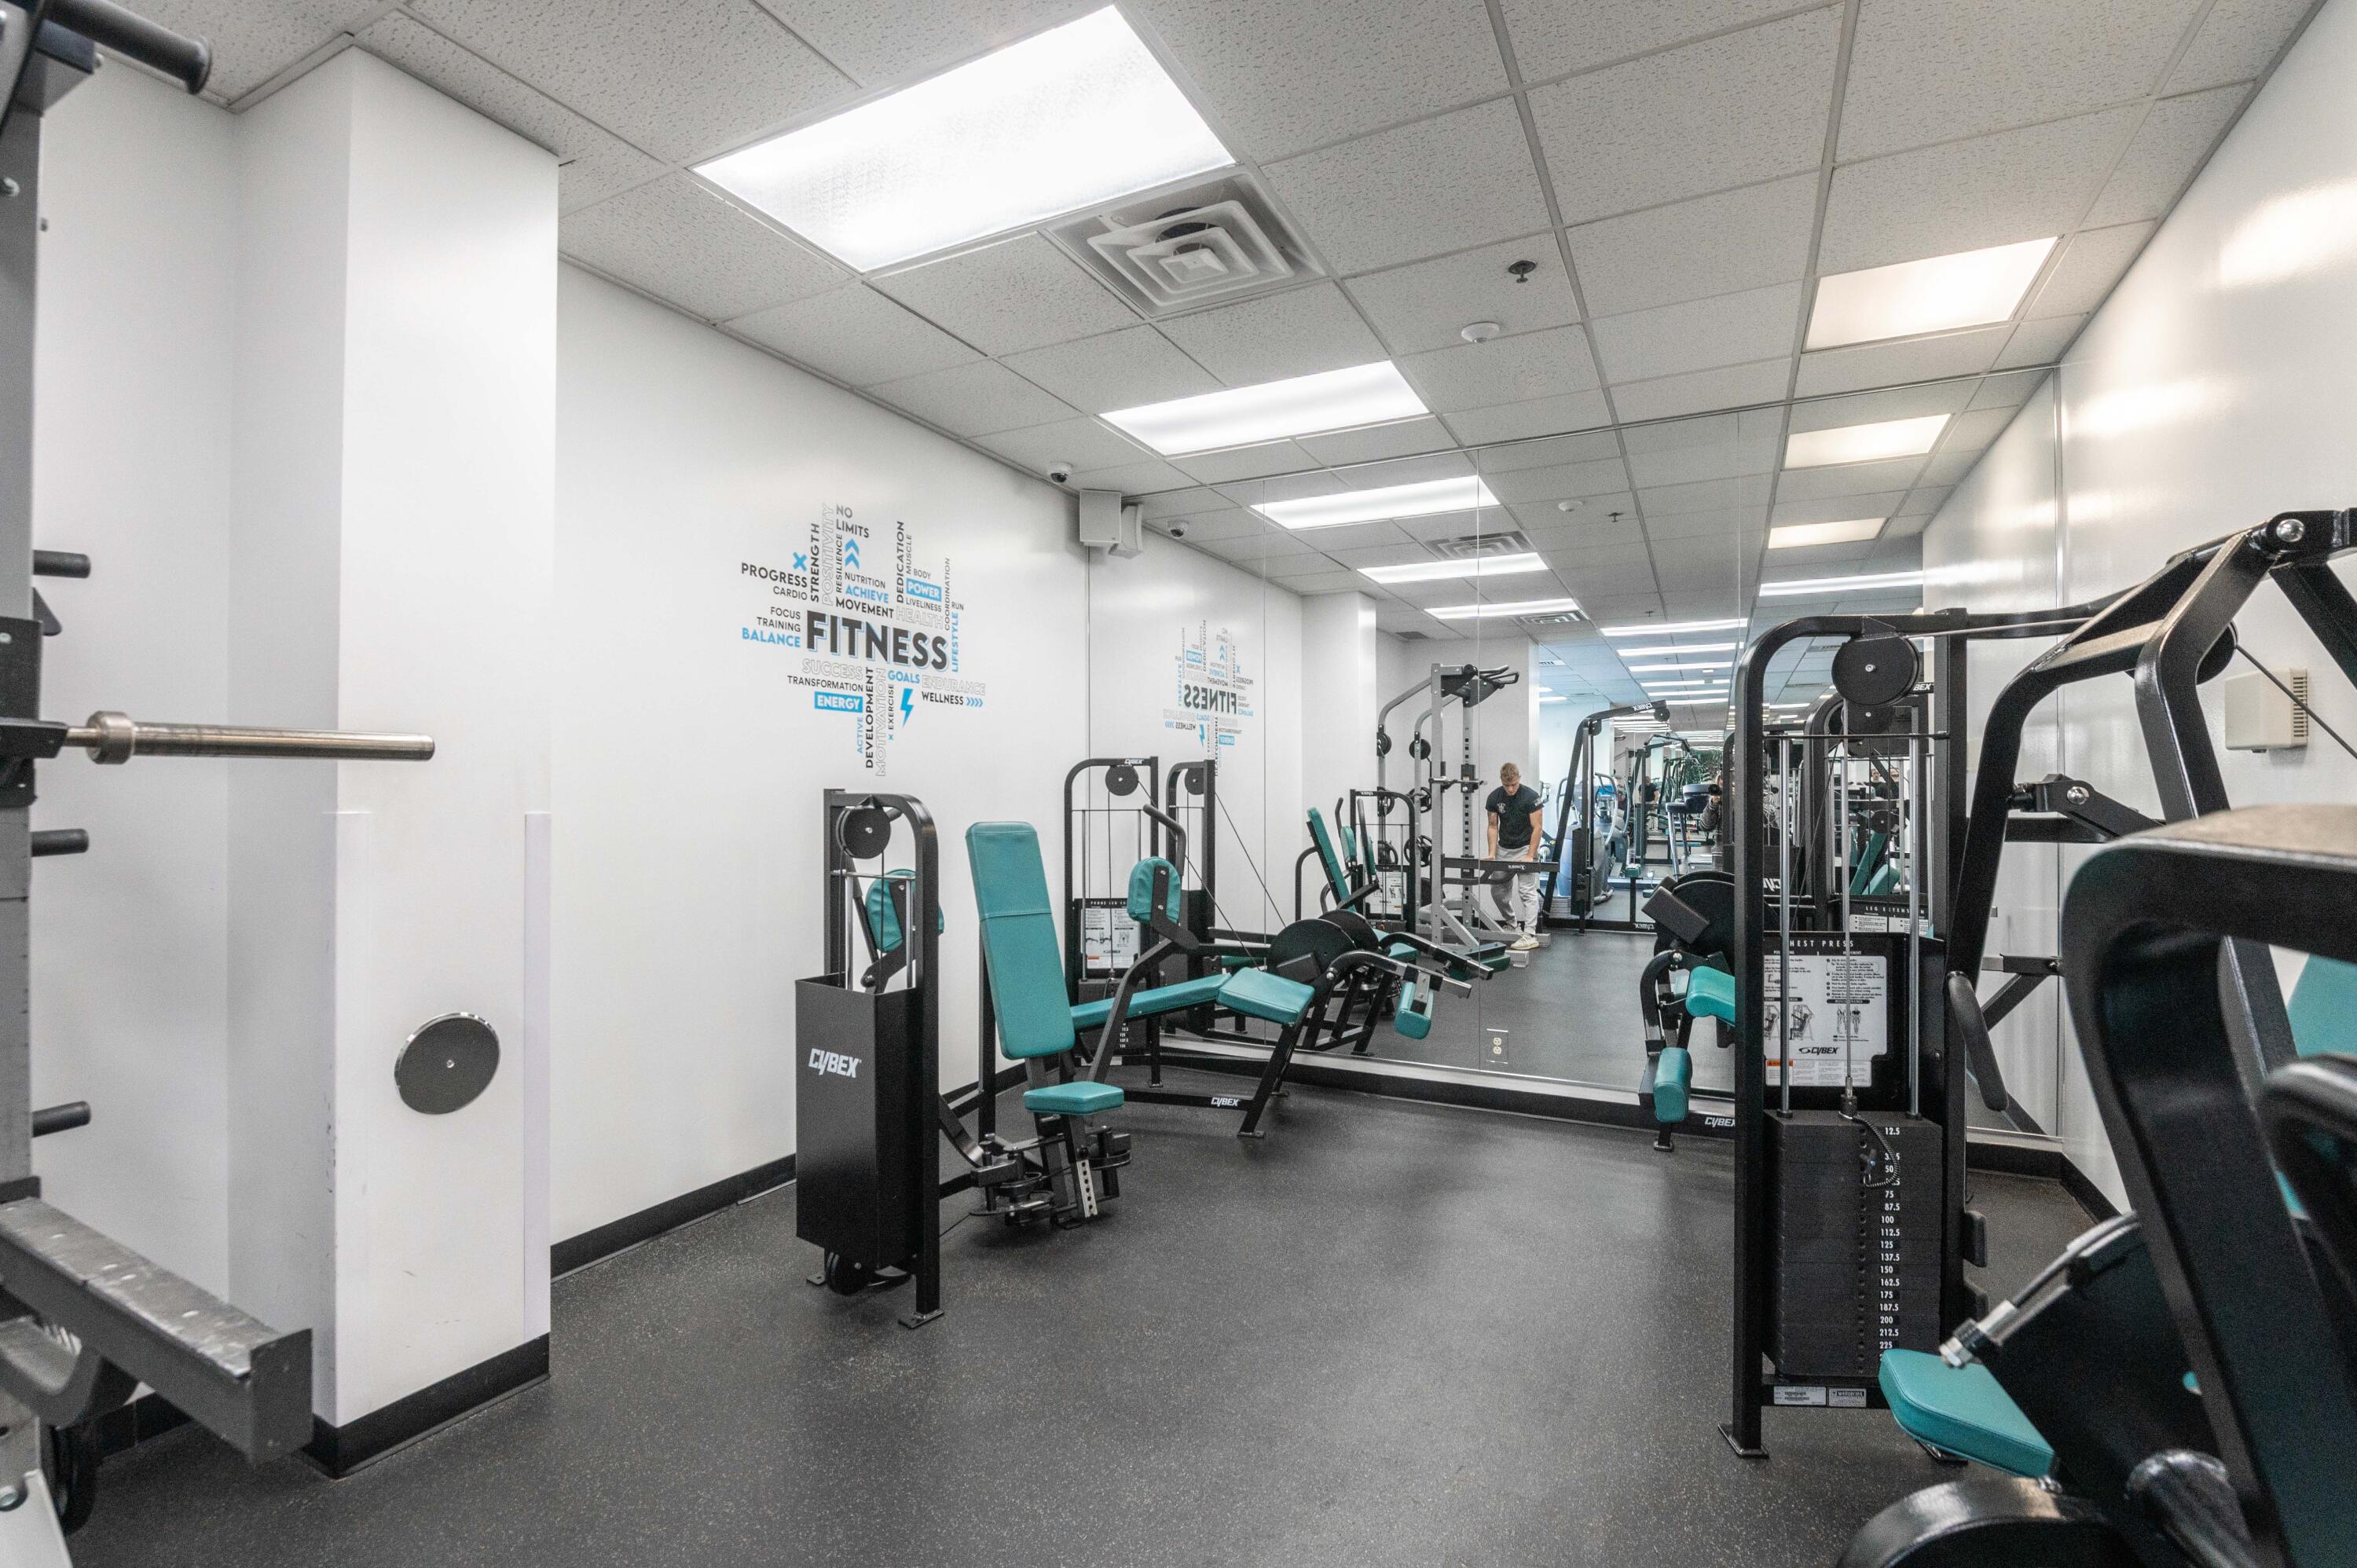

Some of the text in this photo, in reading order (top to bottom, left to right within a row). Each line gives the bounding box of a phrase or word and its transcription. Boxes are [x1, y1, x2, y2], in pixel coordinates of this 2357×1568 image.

[836, 504, 852, 518] NO
[836, 518, 870, 538] LIMITS
[811, 523, 819, 603] STRENGTH
[822, 503, 834, 606] POSITIVITY
[741, 562, 808, 588] PROGRESS
[845, 572, 885, 589] NUTRITION
[913, 568, 931, 580] BODY
[773, 586, 808, 600] CARDIO
[845, 584, 889, 603] ACHIEVE
[907, 580, 940, 600] POWER
[770, 606, 801, 620] FOCUS
[836, 596, 894, 618] MOVEMENT
[906, 597, 942, 612] LIVELINESS
[951, 602, 964, 610] RUN
[757, 617, 801, 632] TRAINING
[896, 606, 944, 630] HEALTH
[742, 627, 801, 647] BALANCE
[807, 610, 949, 671] FITNESS
[802, 658, 863, 680] SUCCESS
[888, 669, 920, 684] GOALS
[787, 675, 863, 692] TRANSFORMATION
[922, 674, 986, 696] ENDURANCE
[817, 694, 860, 710] ENERGY
[922, 691, 964, 705] WELLNESS
[875, 668, 886, 777] MOTIVATION
[808, 1048, 860, 1078] CYBEX
[1211, 1097, 1240, 1107] CYBEX
[1880, 1278, 1900, 1287] 162.5
